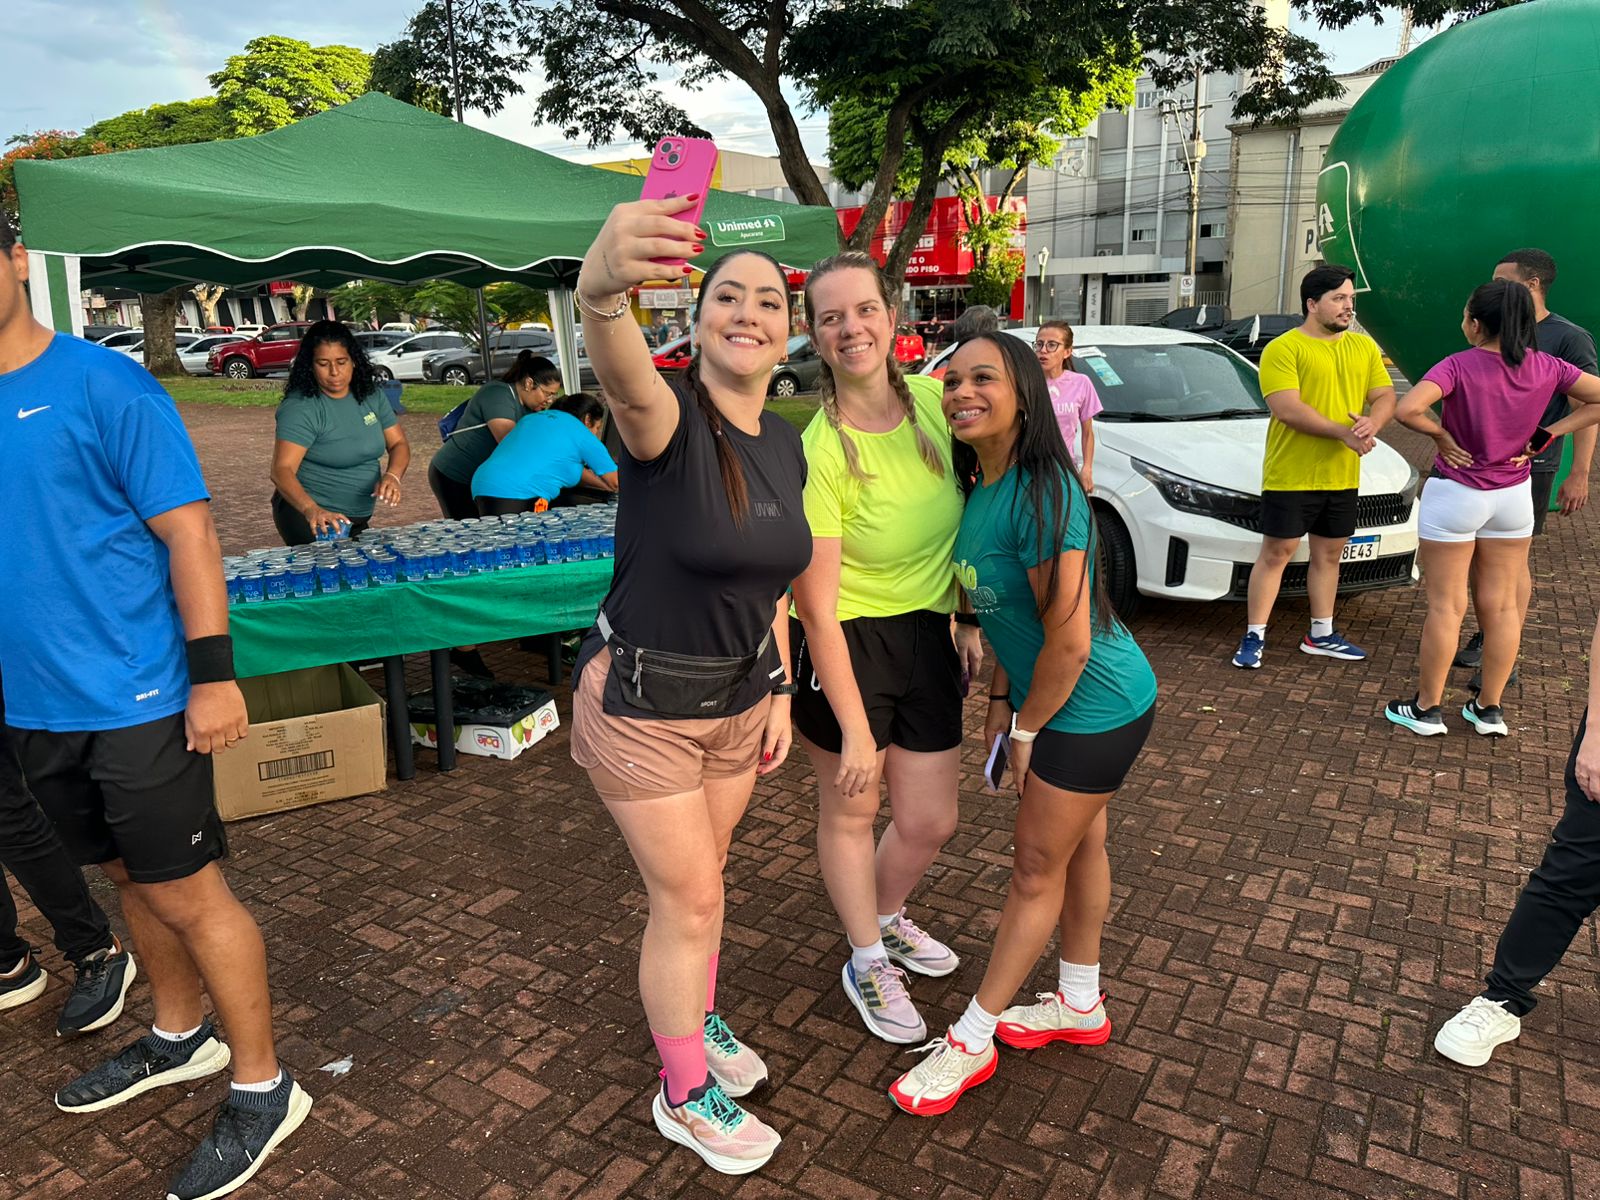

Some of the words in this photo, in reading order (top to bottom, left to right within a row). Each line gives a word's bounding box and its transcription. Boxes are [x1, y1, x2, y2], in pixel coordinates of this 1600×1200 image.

[717, 219, 762, 232] Unimed
[918, 256, 926, 264] O
[920, 265, 940, 273] PISO
[1055, 402, 1074, 414] UM
[1342, 543, 1373, 560] 8E43
[477, 734, 500, 749] Dole
